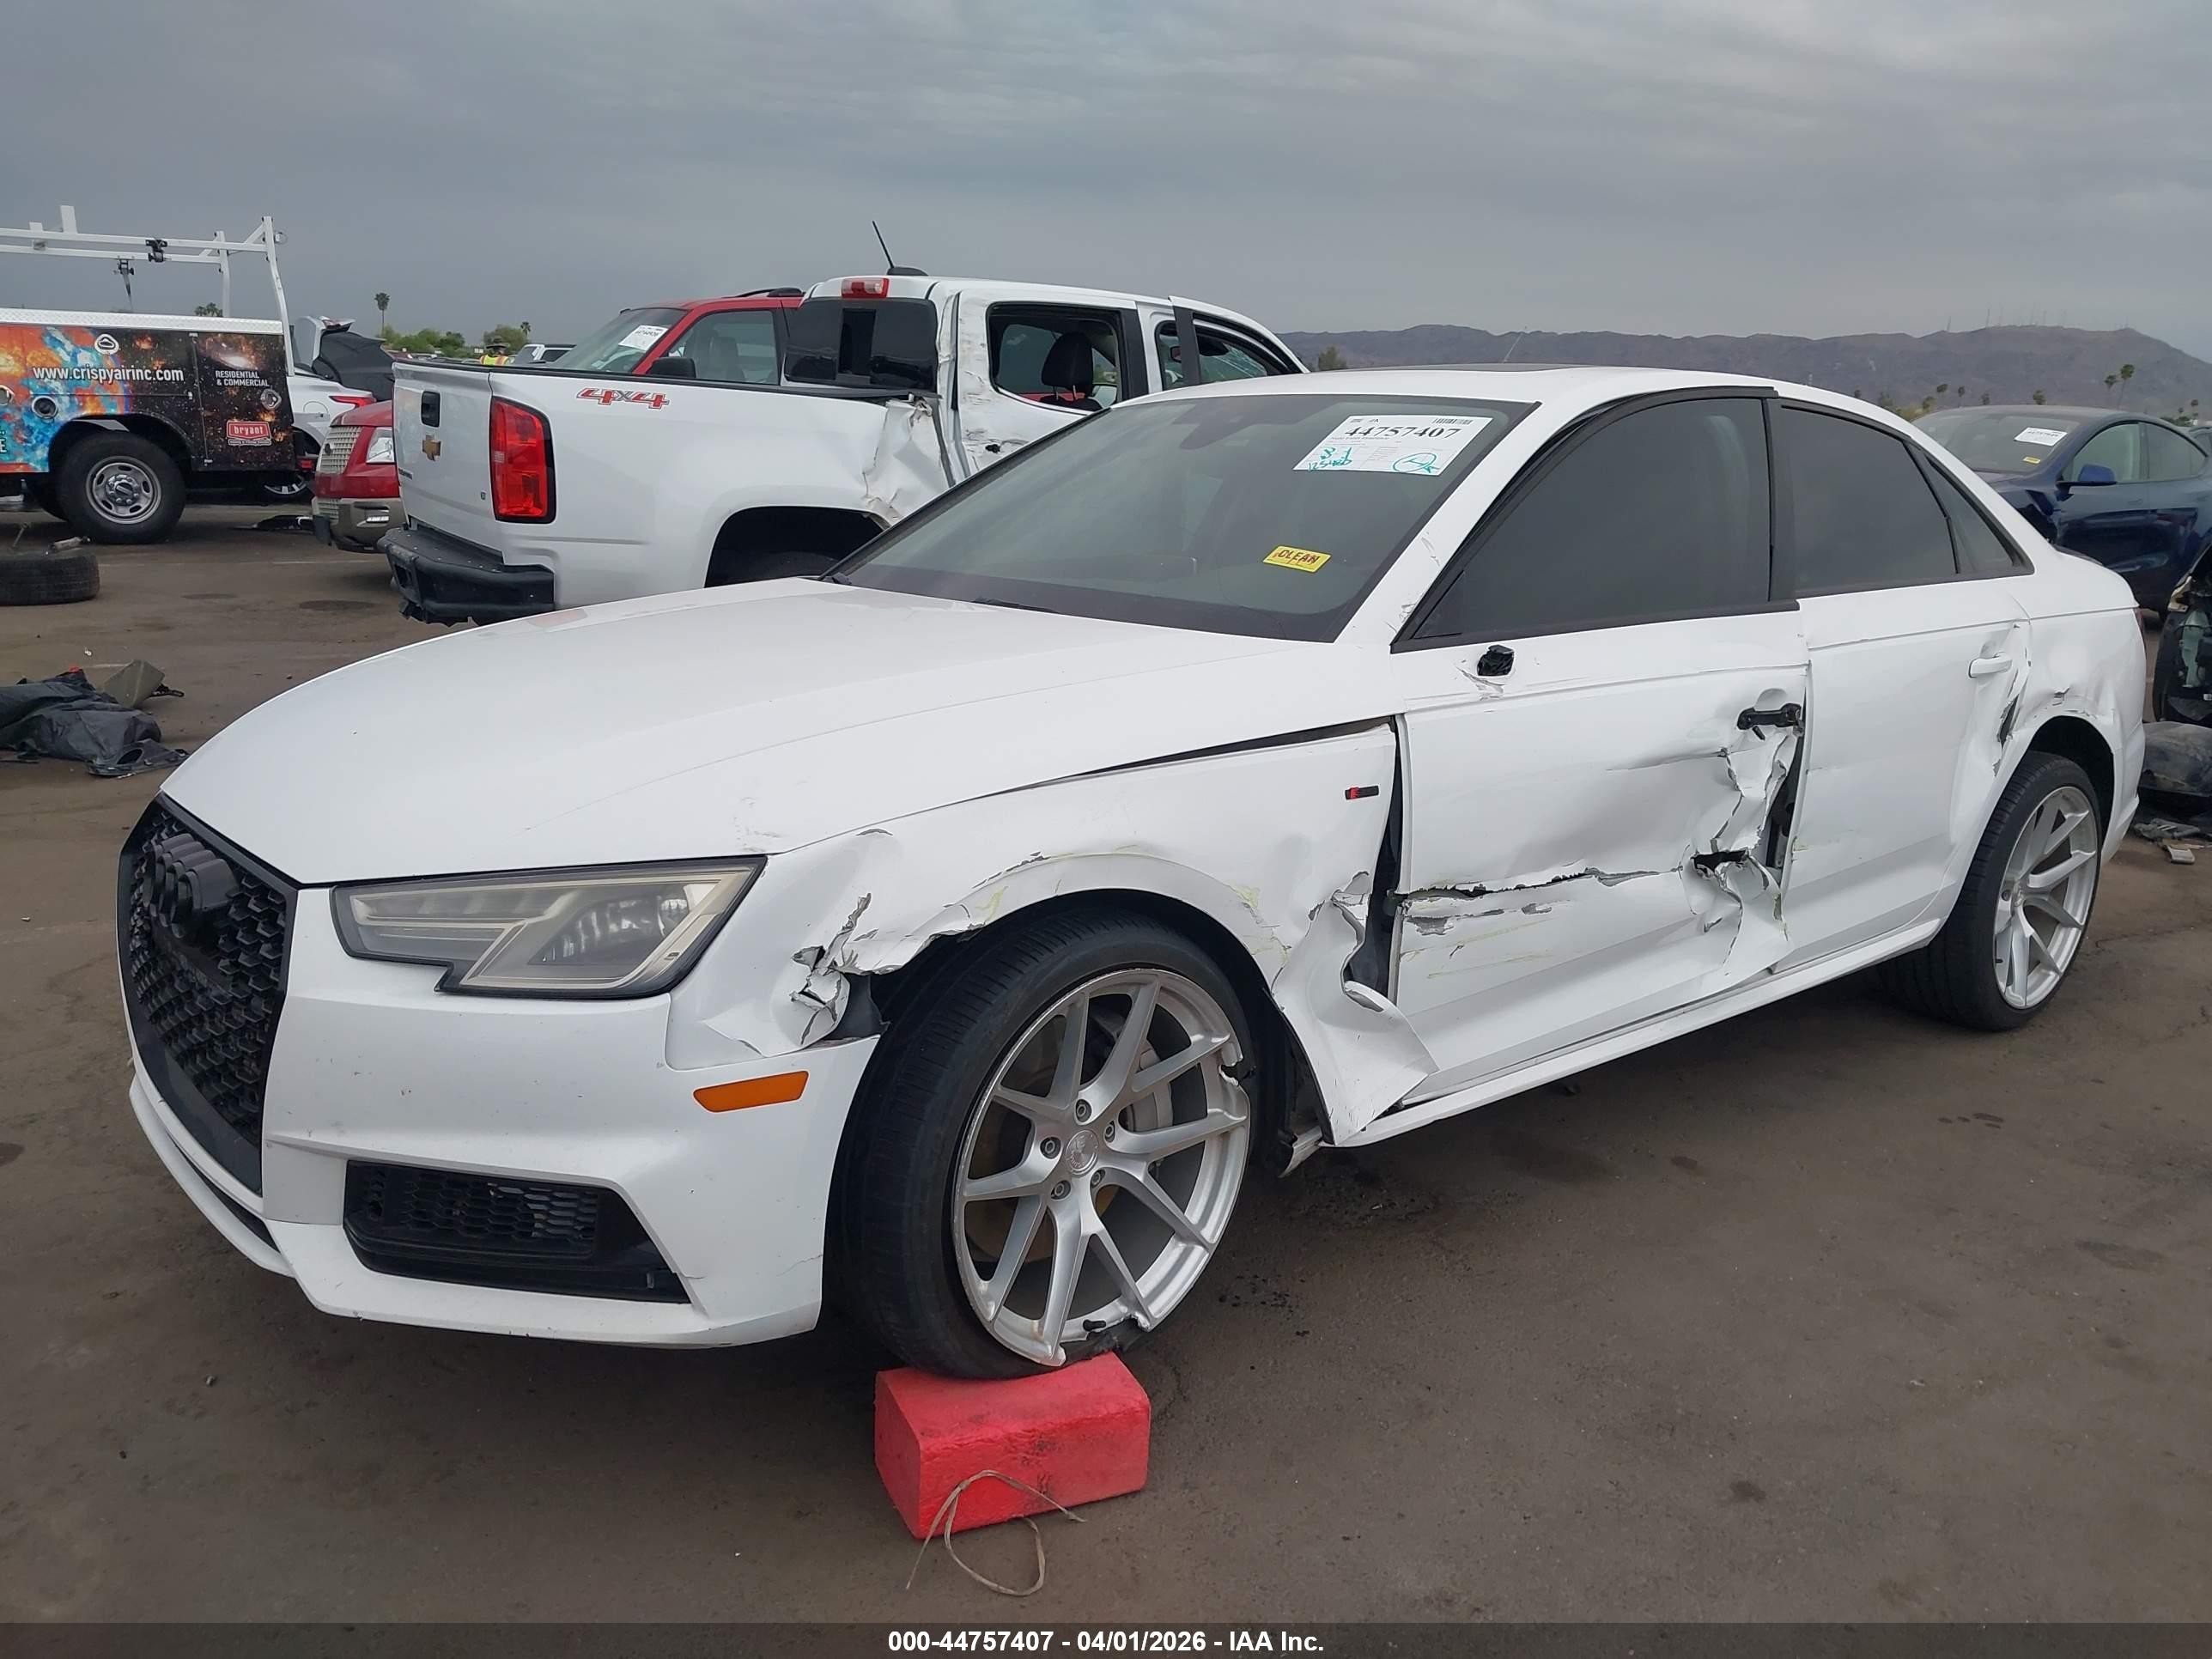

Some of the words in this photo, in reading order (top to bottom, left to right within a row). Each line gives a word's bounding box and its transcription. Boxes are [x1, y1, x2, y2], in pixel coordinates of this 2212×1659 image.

[33, 364, 184, 385] www.crispyairinc.com
[216, 370, 259, 379] RESIDENTIAL
[234, 425, 264, 435] bryant
[1345, 426, 1463, 439] 44757407
